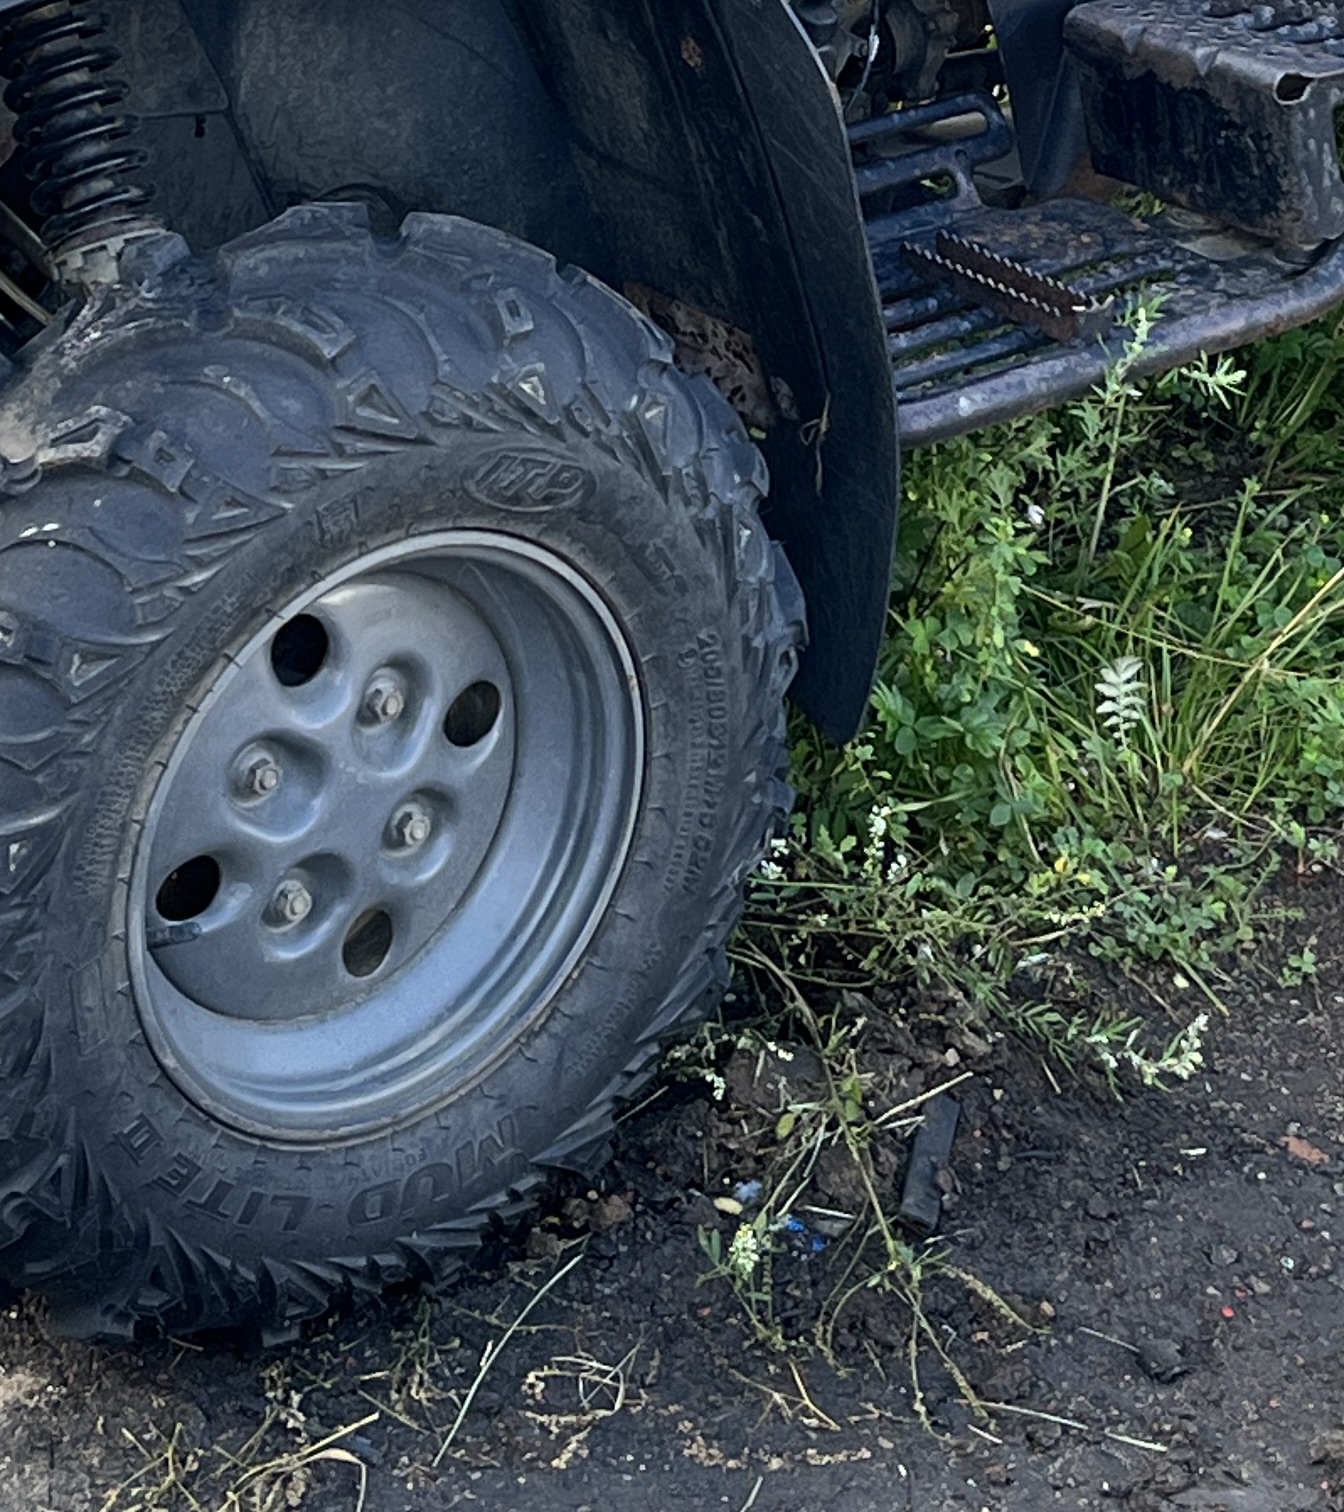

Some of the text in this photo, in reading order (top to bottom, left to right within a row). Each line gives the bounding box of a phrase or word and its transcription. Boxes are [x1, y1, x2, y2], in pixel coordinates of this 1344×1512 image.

[474, 452, 584, 500] ITP
[148, 1154, 312, 1232] LITE
[347, 1114, 523, 1229] MUD
